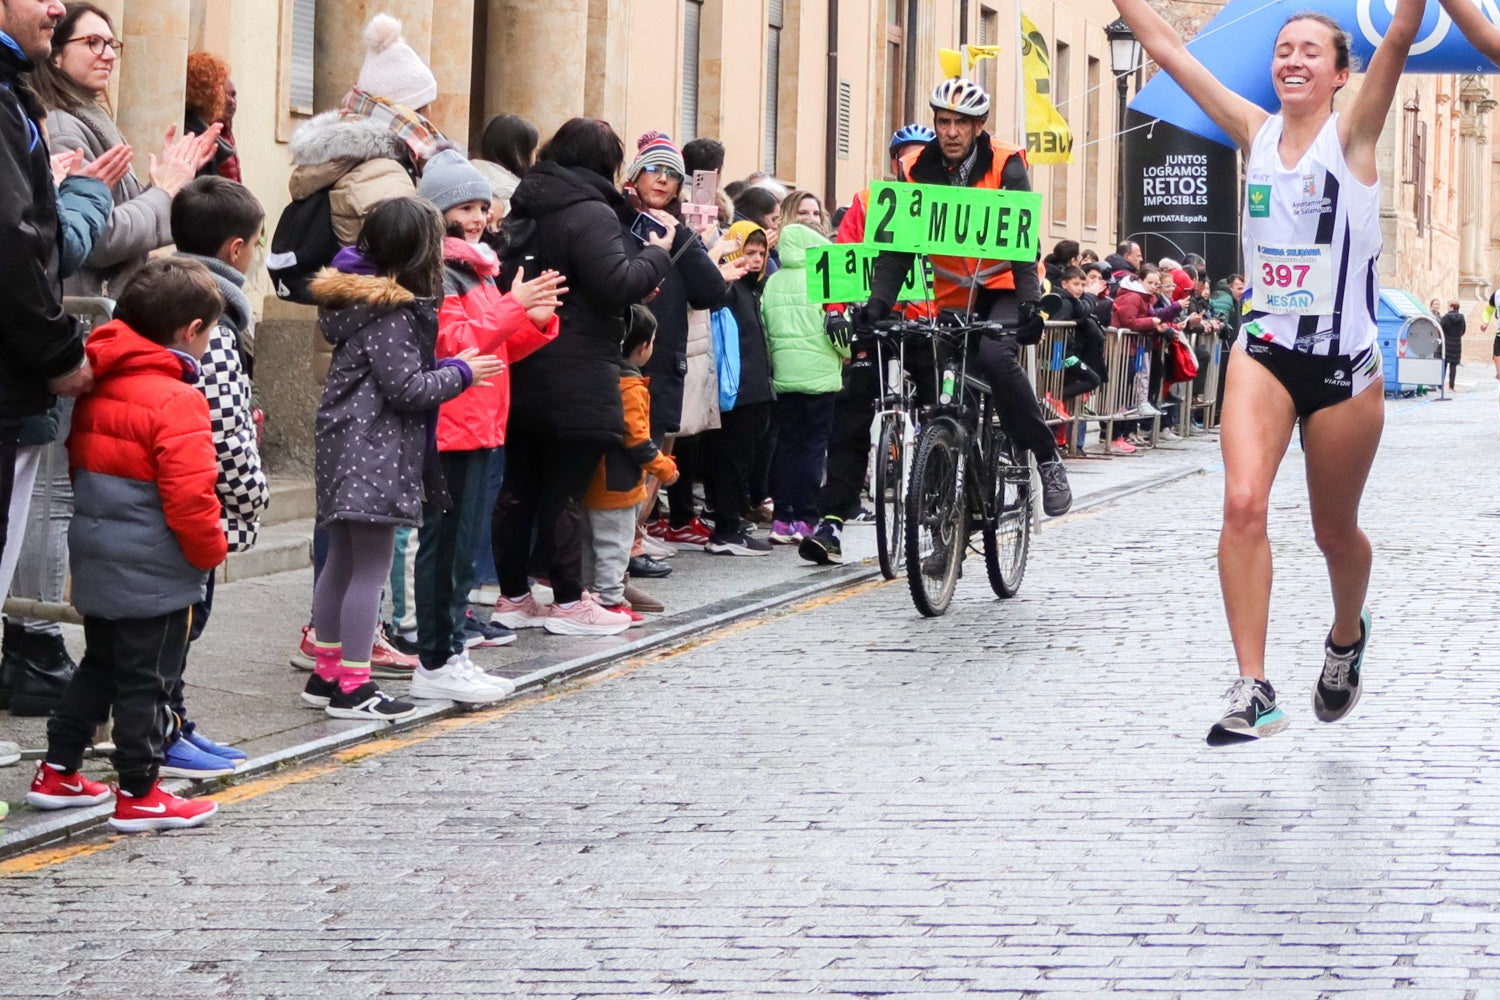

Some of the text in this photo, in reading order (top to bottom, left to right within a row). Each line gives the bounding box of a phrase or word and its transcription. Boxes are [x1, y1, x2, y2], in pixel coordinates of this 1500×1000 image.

[1164, 154, 1208, 166] JUNTOS
[1143, 166, 1208, 177] LOGRAMOS
[1143, 177, 1208, 195] RETOS
[1143, 195, 1208, 206] IMPOSIBLES
[1142, 214, 1208, 223] #NTTDATAEspaña
[928, 201, 1032, 249] MUJER
[1262, 262, 1311, 288] 397
[1267, 294, 1309, 308] HESAN
[1324, 378, 1351, 388] VIATOR
